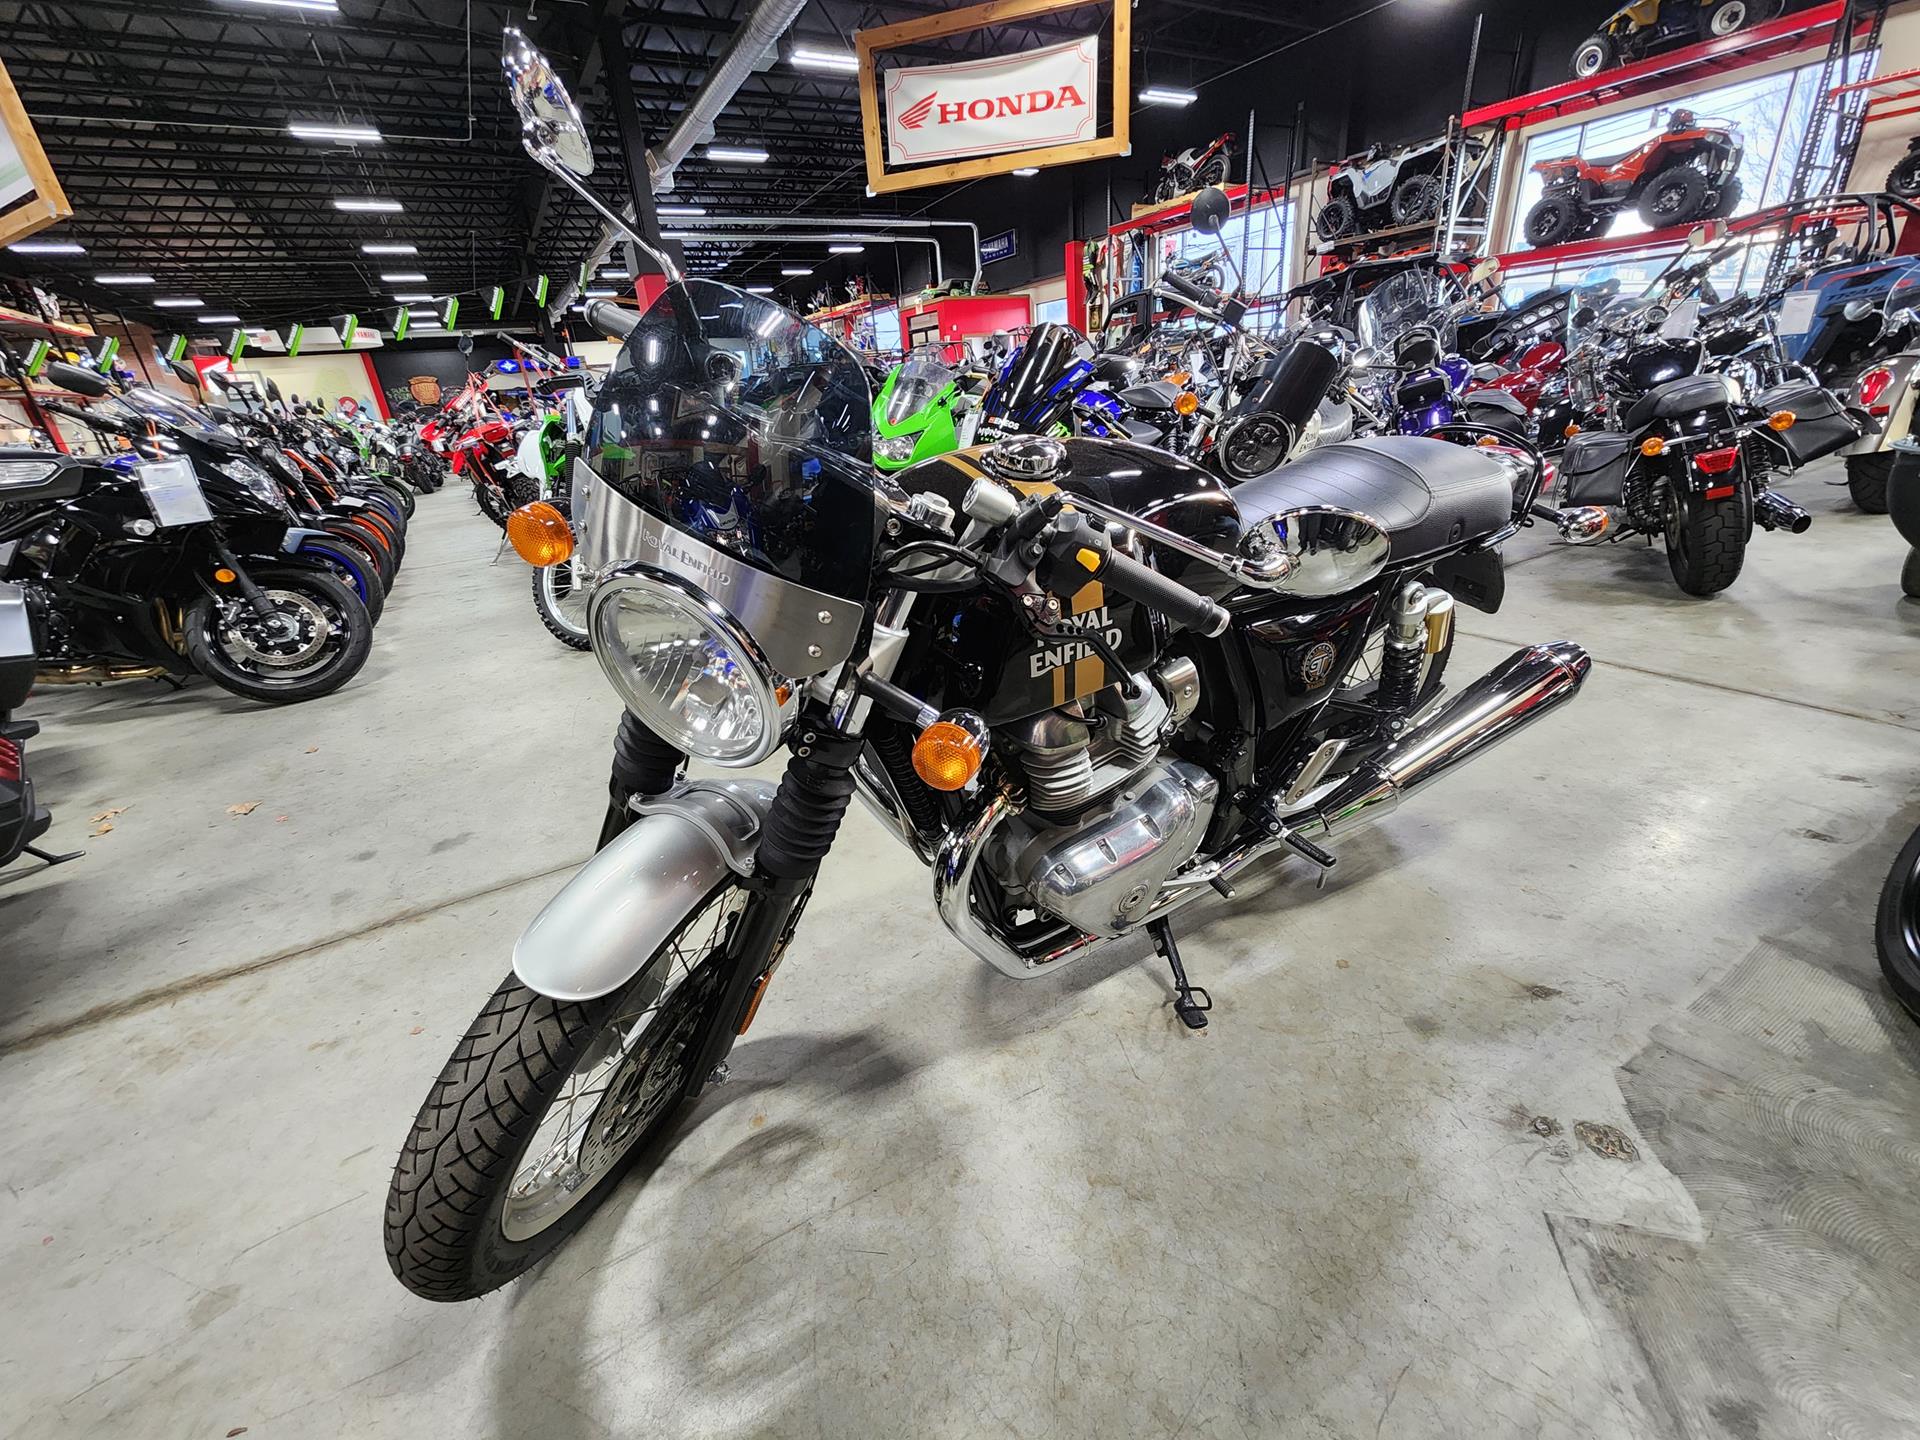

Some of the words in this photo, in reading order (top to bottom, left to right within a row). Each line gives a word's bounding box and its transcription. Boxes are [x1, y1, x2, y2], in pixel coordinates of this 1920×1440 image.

[937, 85, 1086, 125] HONDA
[642, 528, 680, 560] ROYAL
[680, 549, 731, 586] ENFIELD
